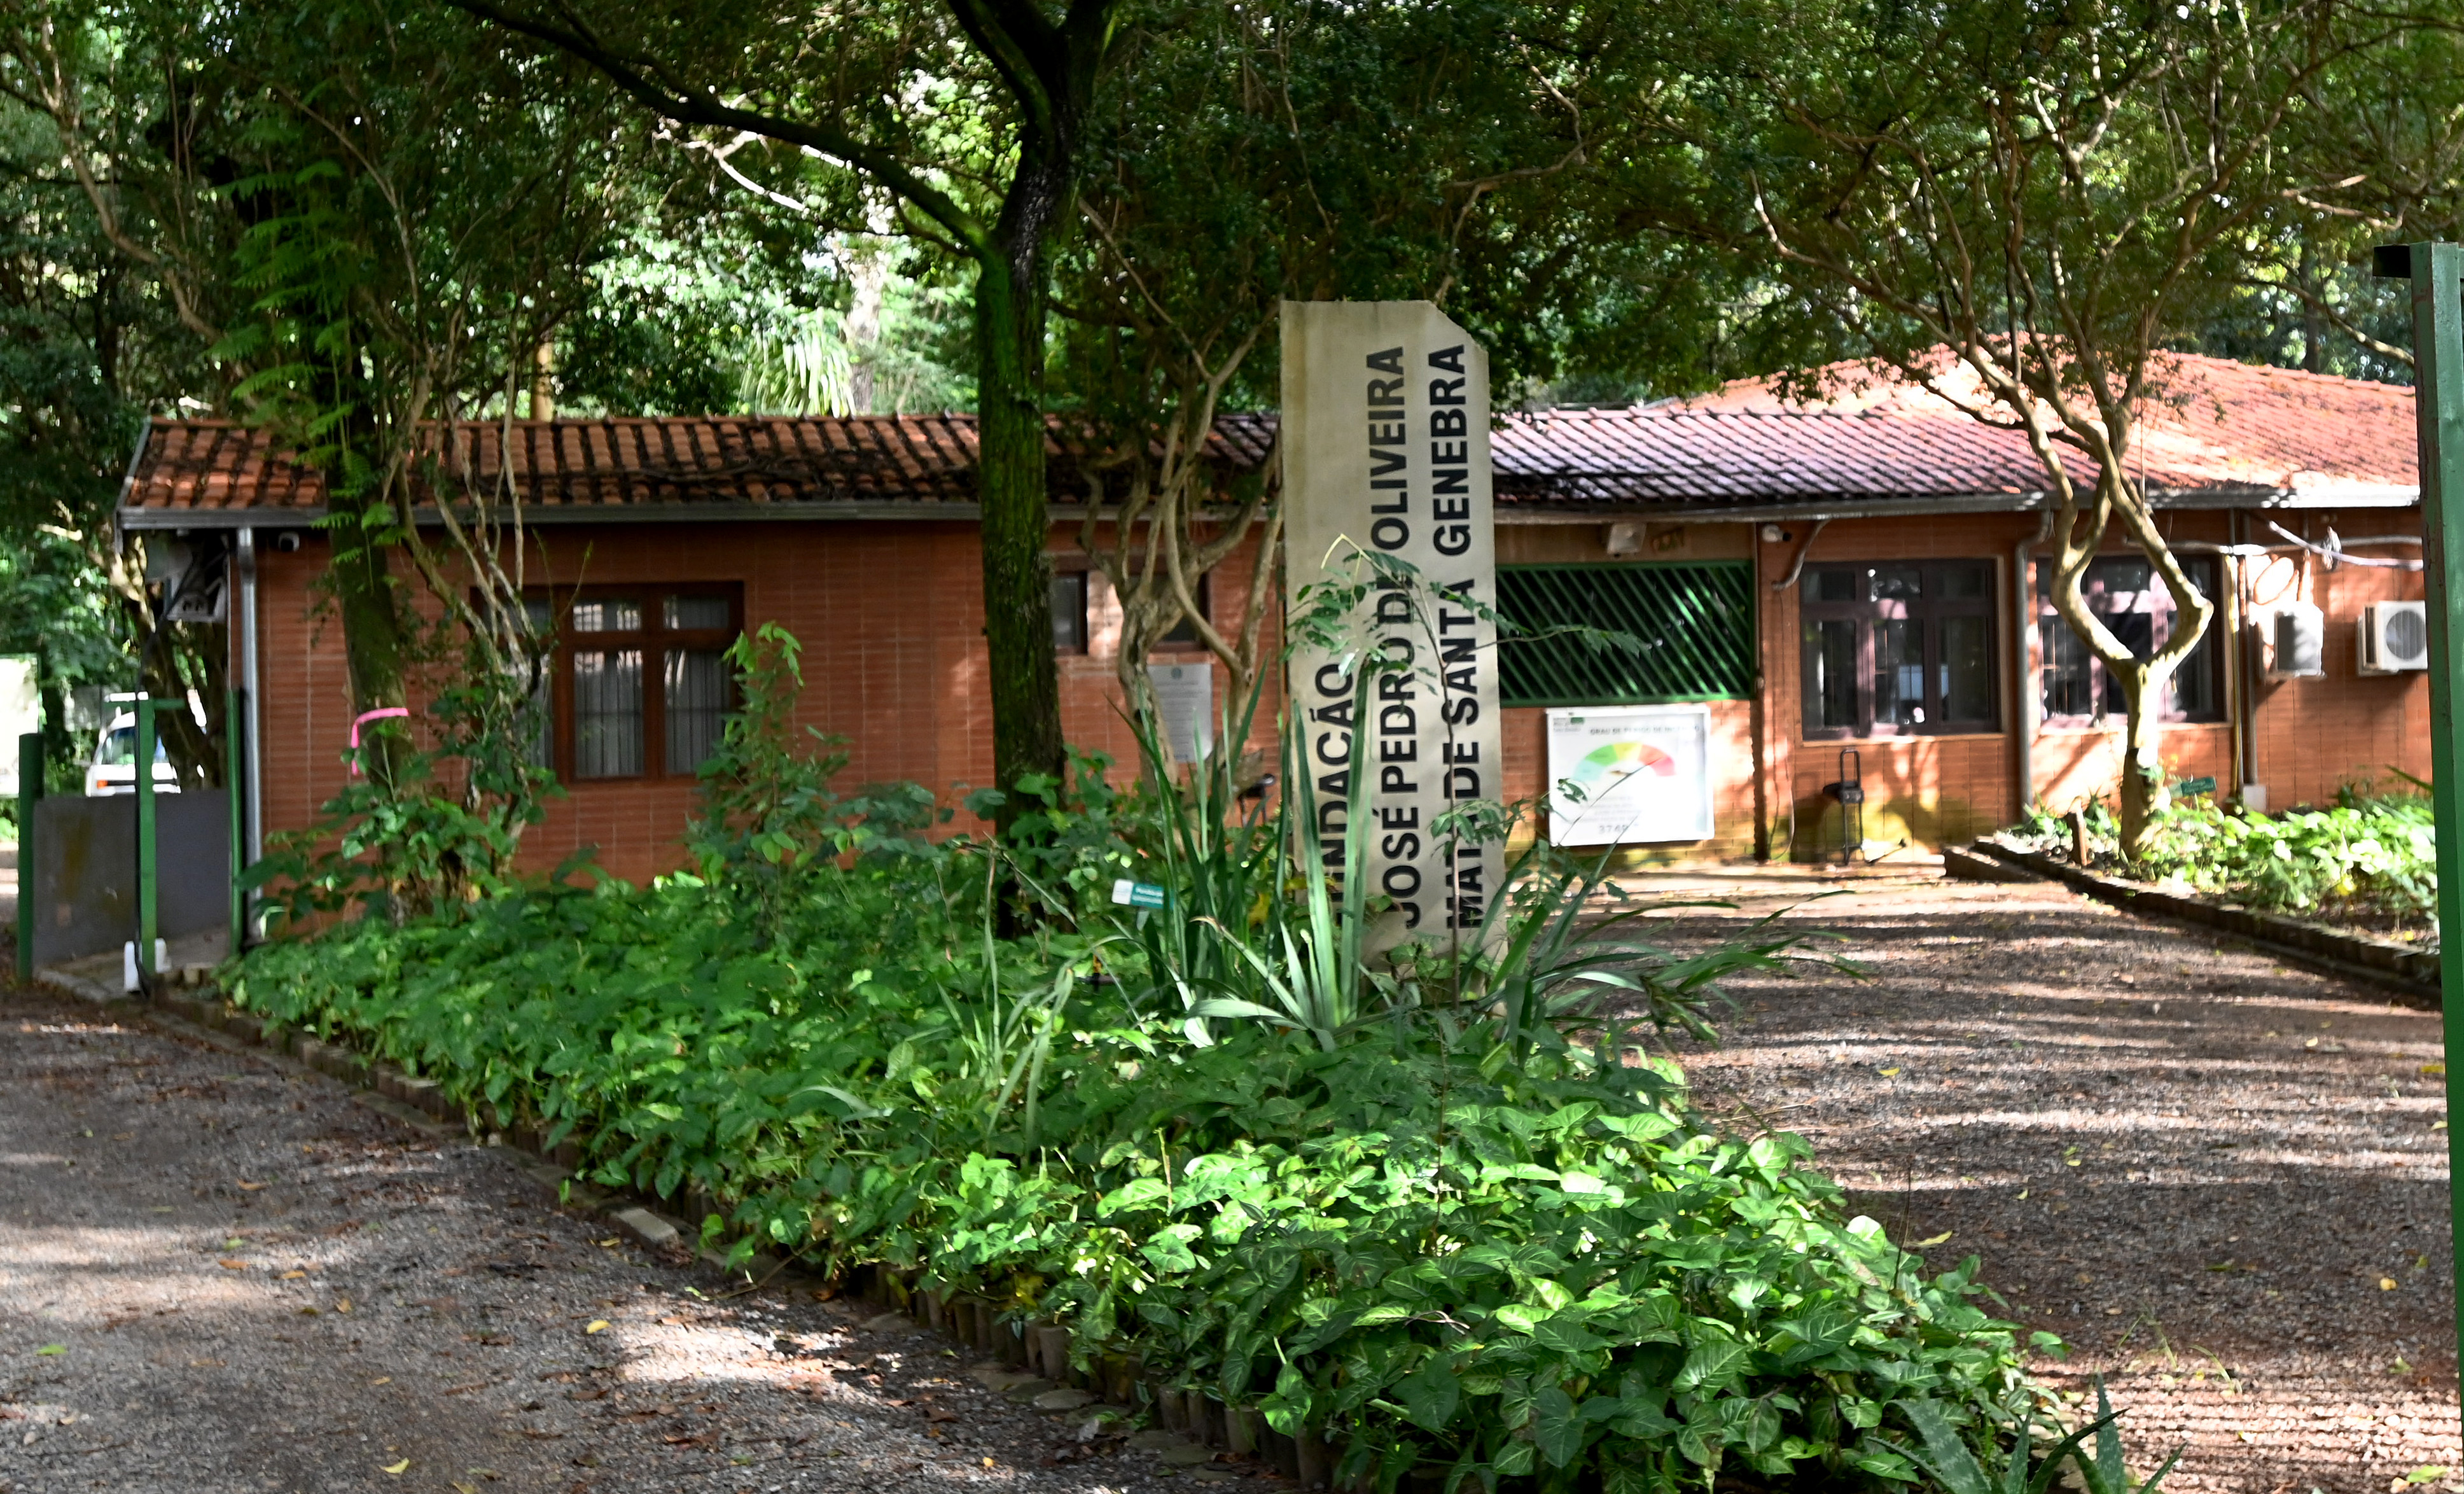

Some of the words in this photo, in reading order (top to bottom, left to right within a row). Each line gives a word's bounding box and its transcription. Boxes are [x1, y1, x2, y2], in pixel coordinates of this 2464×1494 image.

[1366, 346, 1409, 551] OLIVEIRA
[1428, 344, 1470, 557] GENEBRA
[1376, 637, 1418, 794] PEDRO
[1438, 578, 1479, 727] SANTA
[1309, 664, 1355, 927] NDAÇÃO
[1442, 741, 1479, 799] DE
[1371, 807, 1421, 930] JOSÉ
